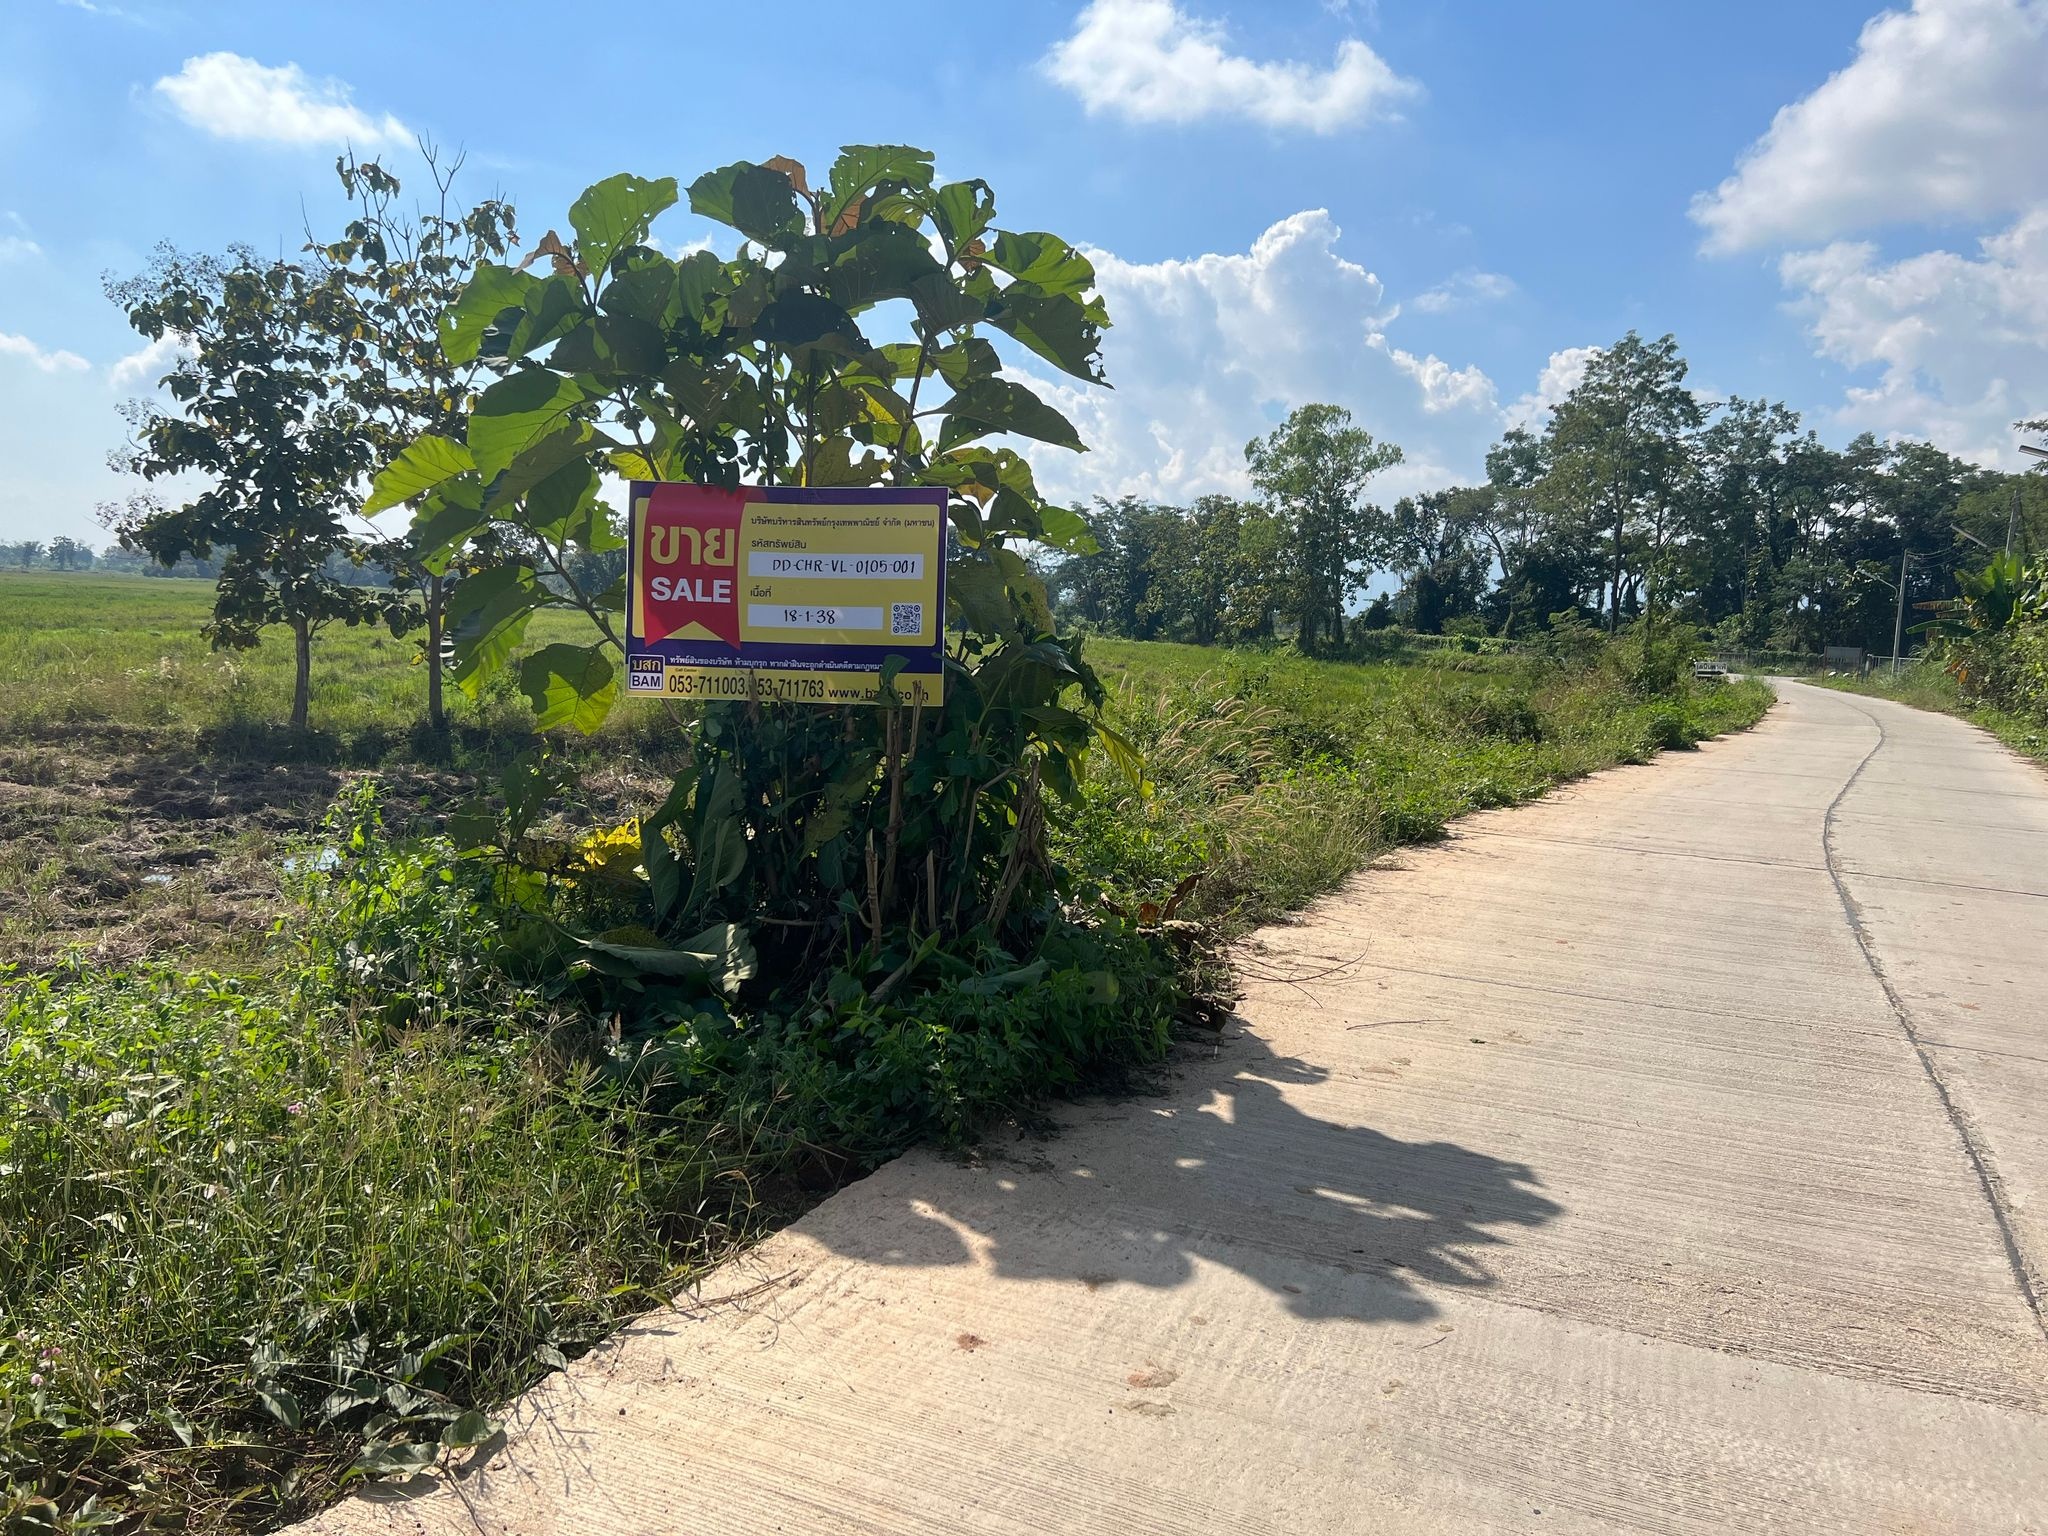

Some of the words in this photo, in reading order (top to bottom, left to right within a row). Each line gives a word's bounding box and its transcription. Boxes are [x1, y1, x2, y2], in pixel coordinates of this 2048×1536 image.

[883, 517, 901, 527] จำกัด
[904, 519, 935, 528] (มหาชน)
[650, 525, 735, 567] ขาย
[751, 539, 807, 549] รหัสทรัพย์สิน
[772, 559, 915, 575] DD-CHR-VL-0105-001
[651, 576, 731, 603] SALE
[750, 585, 772, 598] เนื้อที่
[784, 609, 835, 624] 18-1-38
[632, 659, 661, 671] บสก
[770, 659, 883, 672] หากฝ่าฝืนจะถูกดำเนินคดีตามกฎหมา
[632, 675, 660, 687] BAM
[669, 675, 749, 697] 053-711003,
